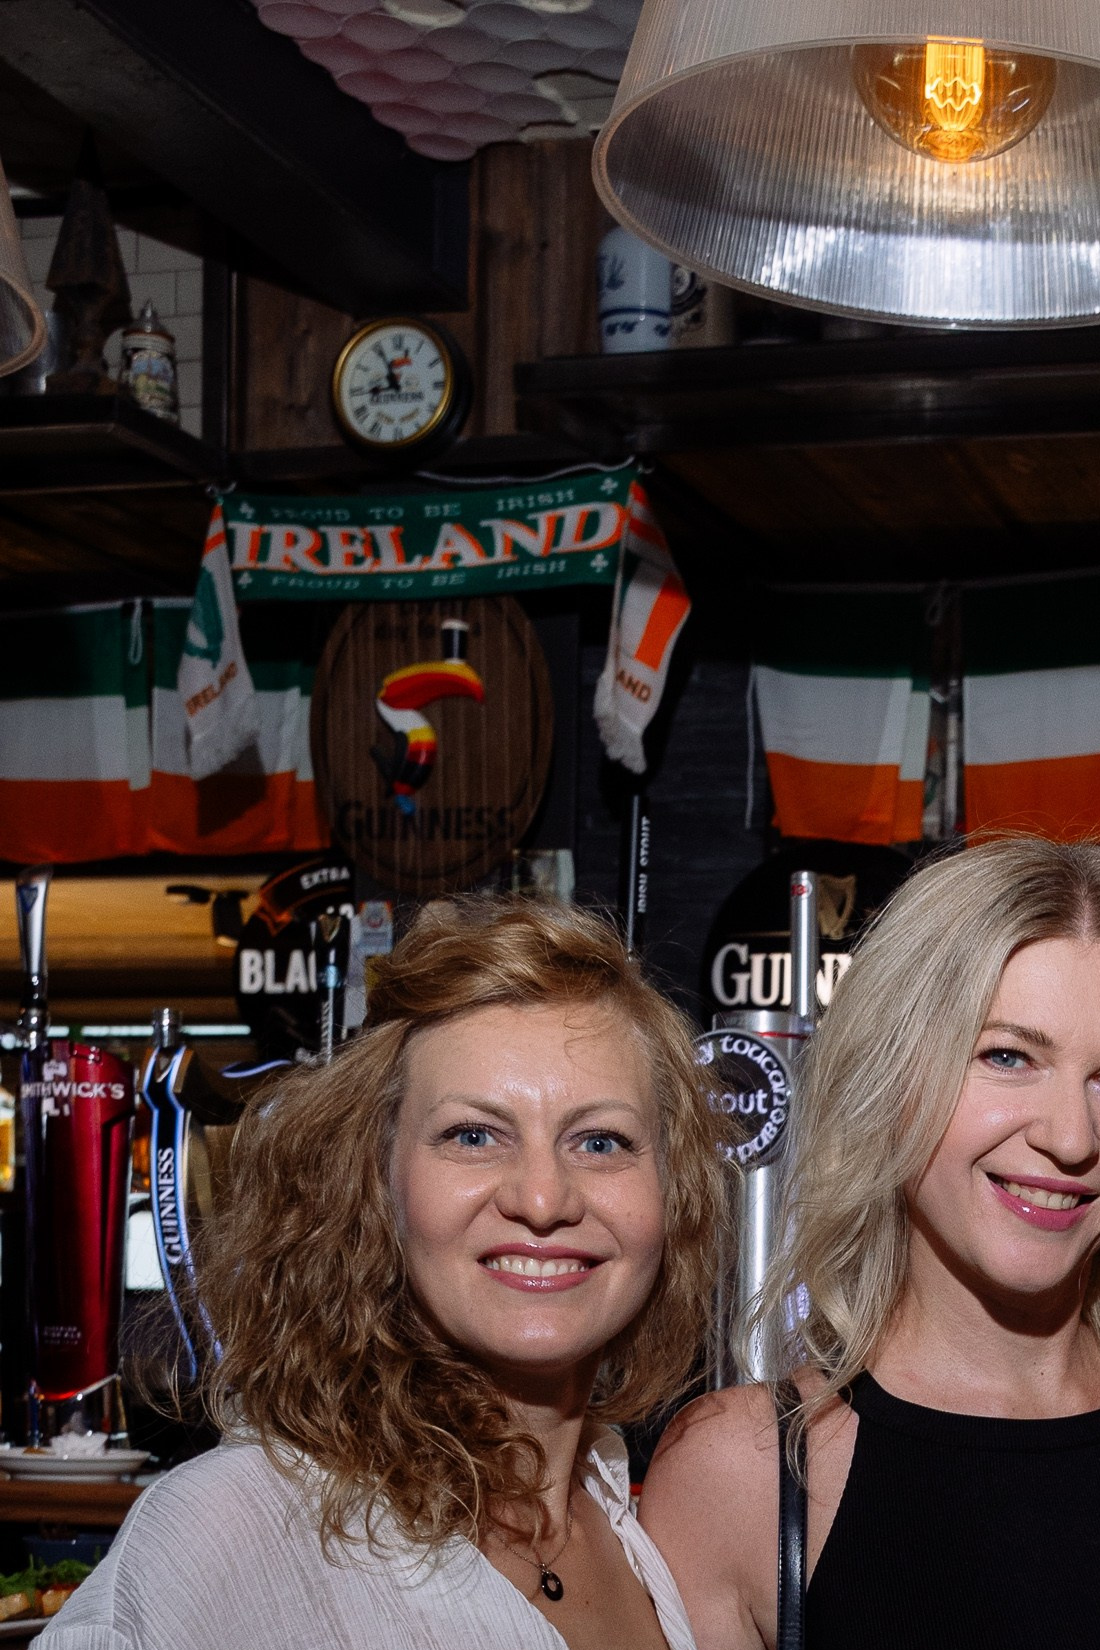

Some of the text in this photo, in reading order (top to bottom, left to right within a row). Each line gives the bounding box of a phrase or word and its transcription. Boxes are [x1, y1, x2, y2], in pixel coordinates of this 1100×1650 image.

[369, 506, 404, 520] TO
[423, 503, 462, 518] BE
[497, 488, 576, 512] IRISH
[226, 500, 631, 575] IRELAND
[381, 577, 414, 590] TO
[431, 573, 465, 587] BE
[497, 560, 567, 579] IRISH
[300, 866, 350, 890] EXTRA
[705, 1087, 769, 1114] tout
[158, 1147, 184, 1265] GUINNESS
